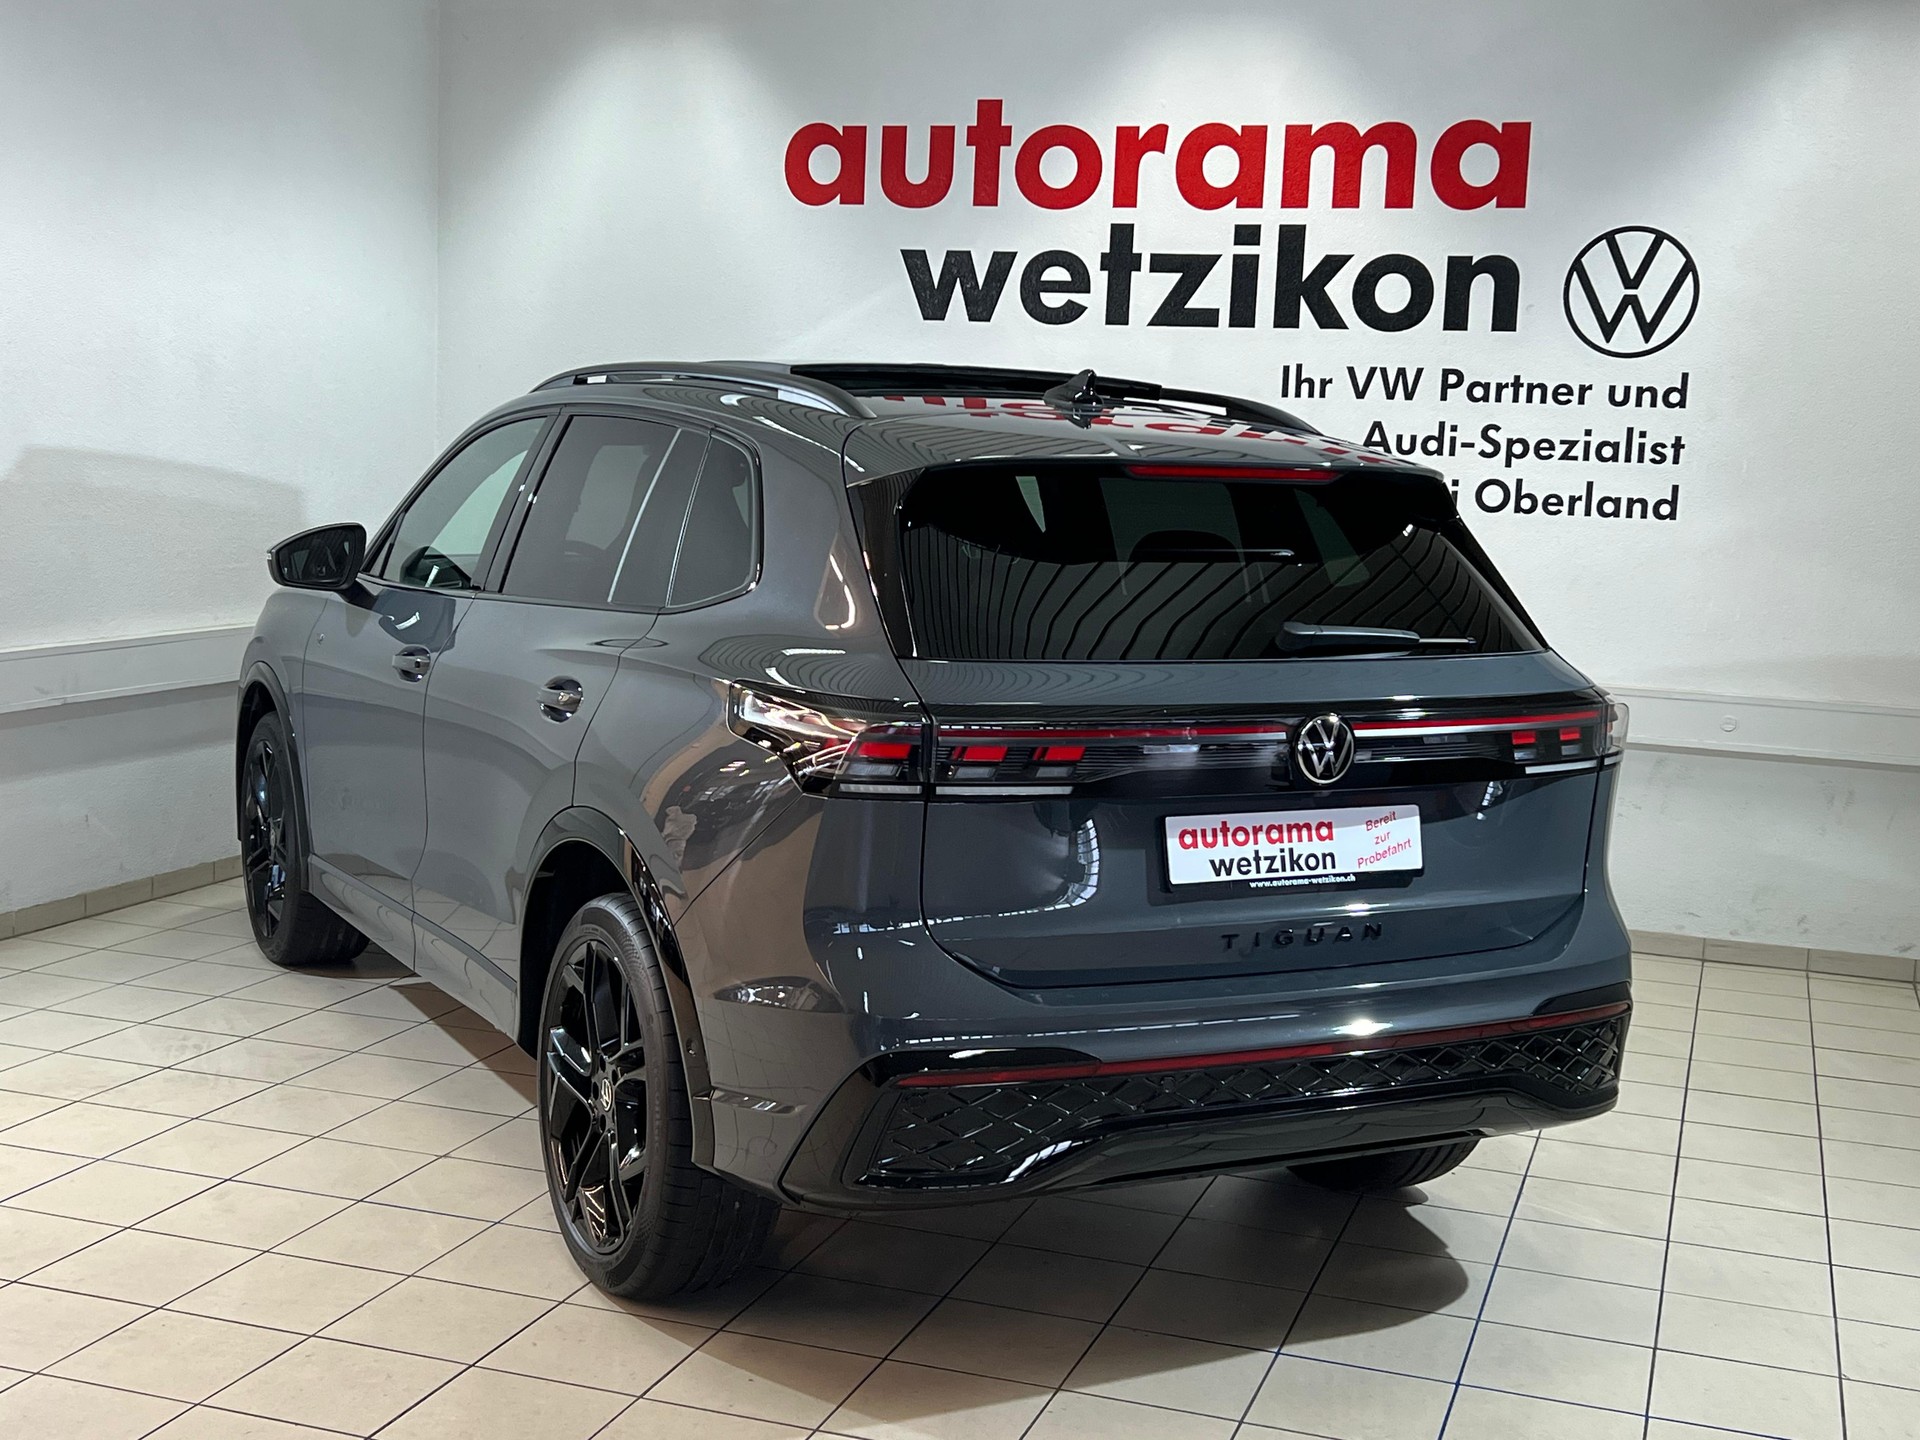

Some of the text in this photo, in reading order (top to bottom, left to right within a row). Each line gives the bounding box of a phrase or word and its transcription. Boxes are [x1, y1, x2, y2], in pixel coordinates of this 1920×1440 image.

[784, 98, 1531, 211] autorama
[899, 222, 1520, 333] wetzikon
[1281, 363, 1690, 409] Ihr VW Partner und
[1362, 420, 1686, 468] Audi-Spezialist
[1474, 478, 1681, 521] Oberland
[1178, 820, 1334, 850] autorama
[1365, 810, 1397, 832] Bereit
[1357, 837, 1412, 869] Probefahrt
[1374, 830, 1391, 846] zur
[1209, 847, 1336, 877] wetzikon
[1249, 873, 1356, 888] www.autorama-wetzikon.ch
[1221, 922, 1382, 950] TIGUAN
